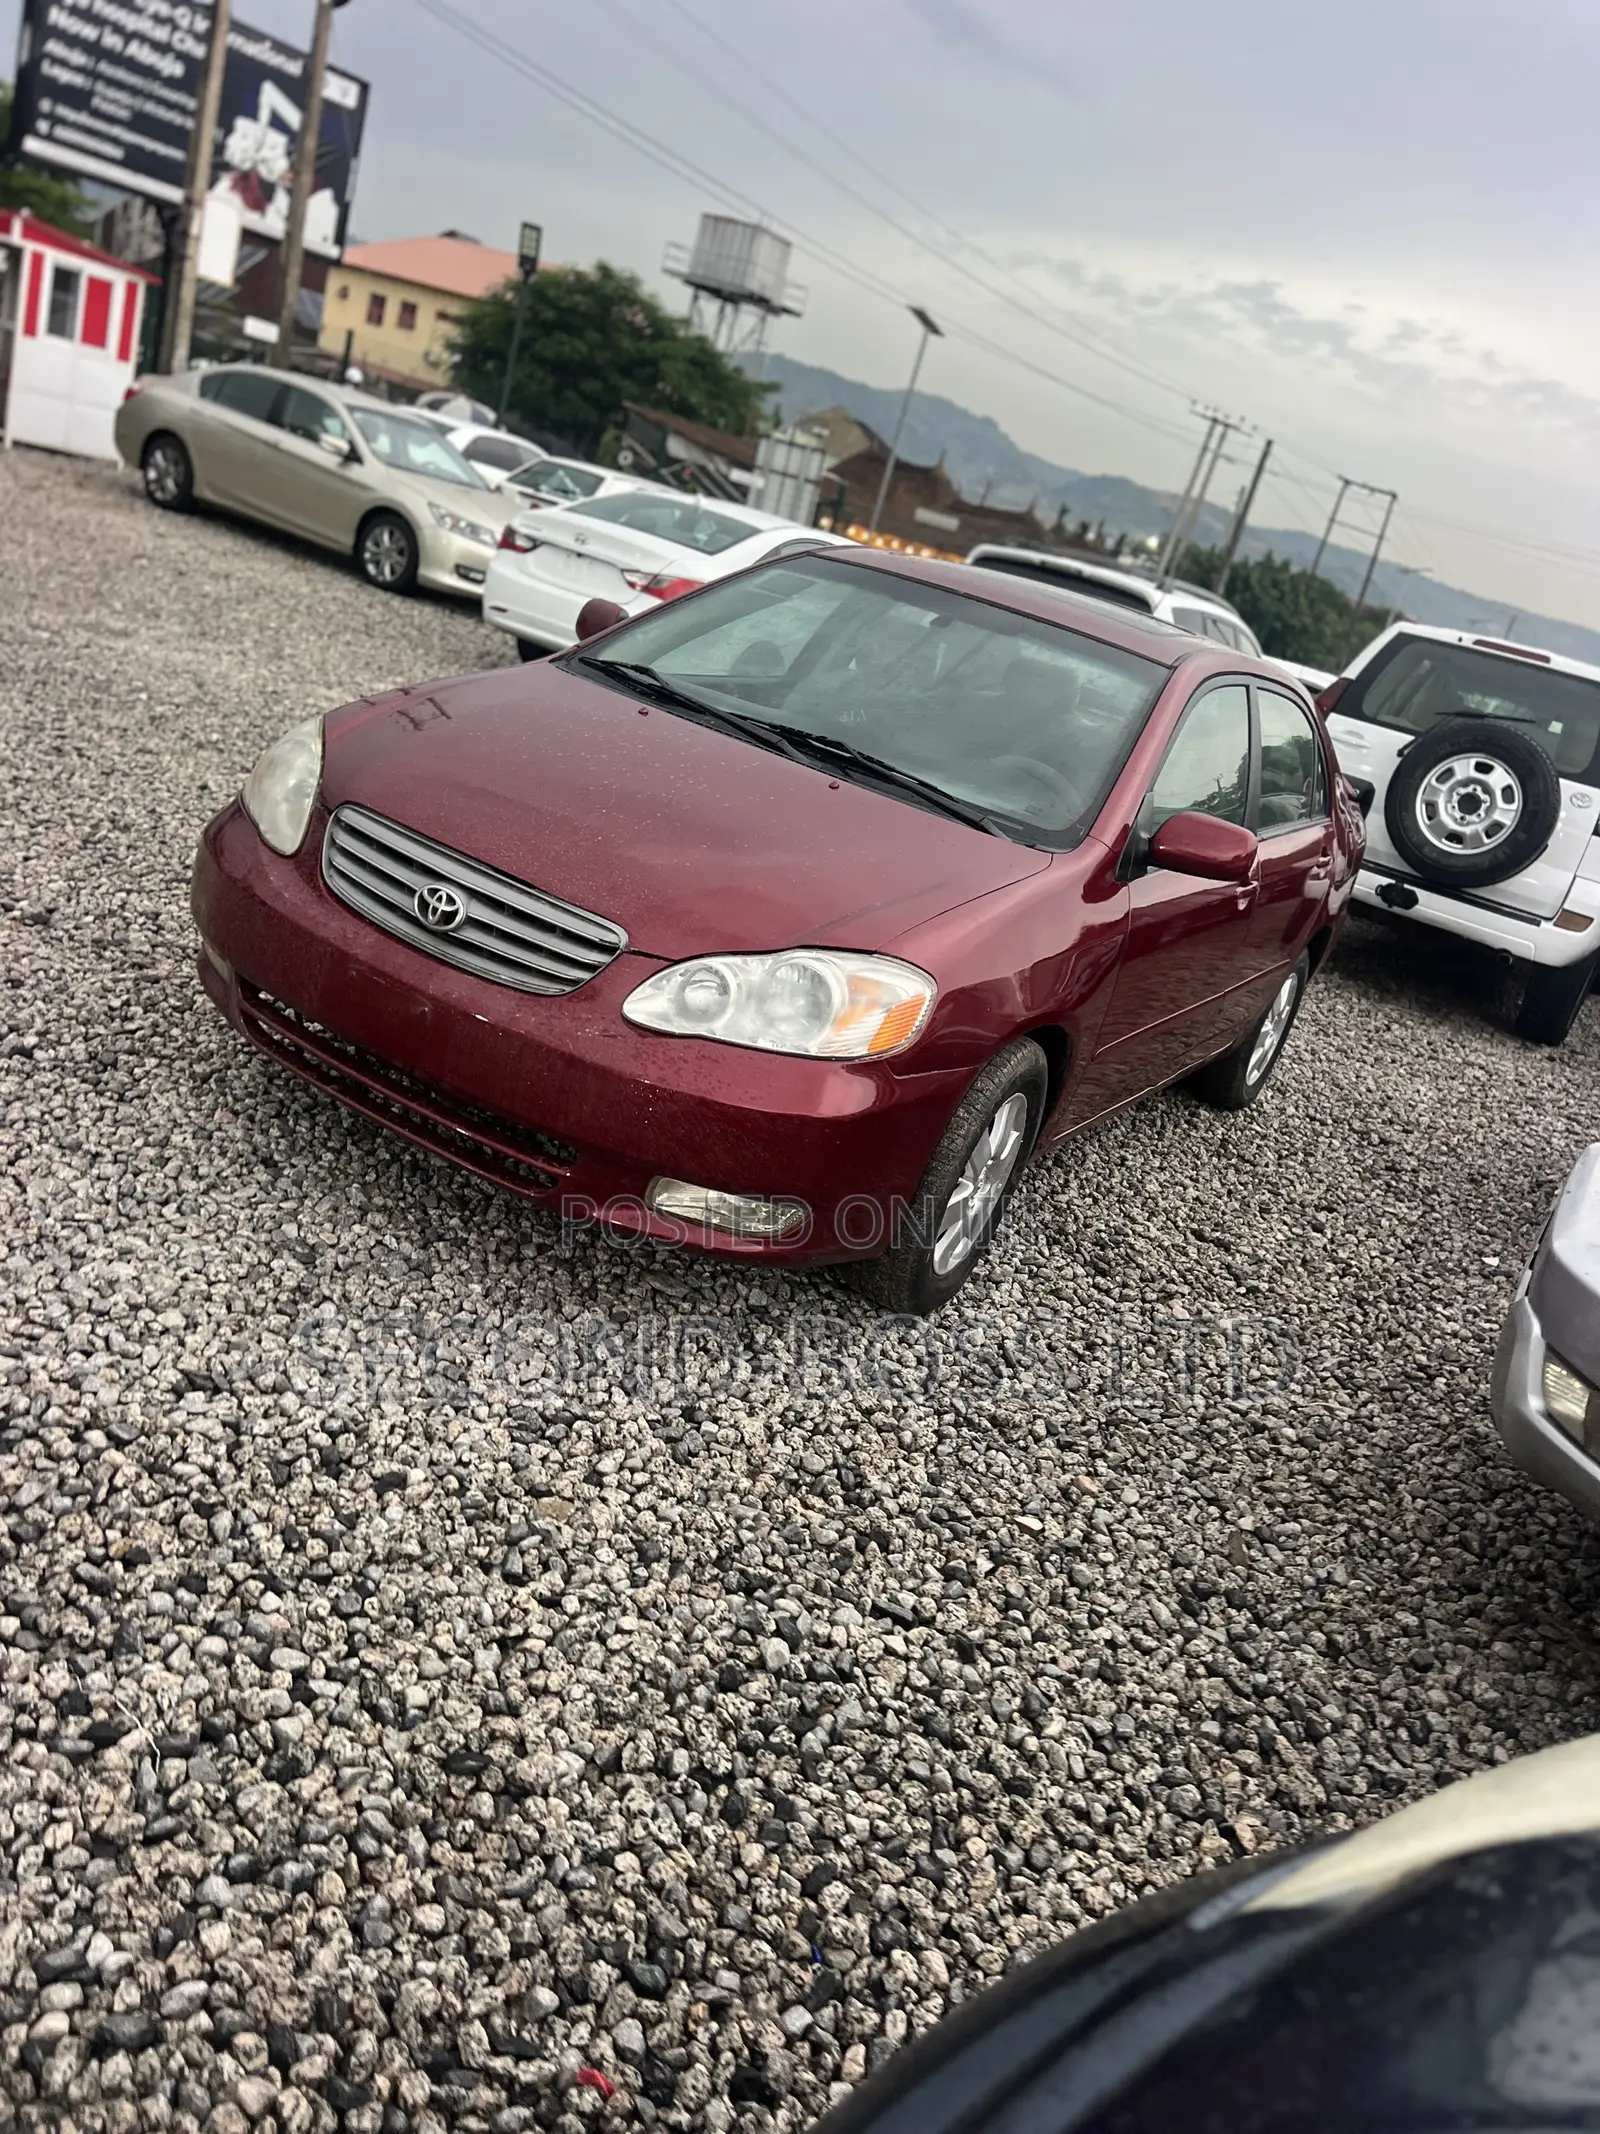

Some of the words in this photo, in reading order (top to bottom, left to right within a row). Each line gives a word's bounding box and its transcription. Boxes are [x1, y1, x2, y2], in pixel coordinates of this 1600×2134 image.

[47, 4, 100, 42] Now
[100, 25, 125, 53] in
[123, 38, 186, 78] Abuja
